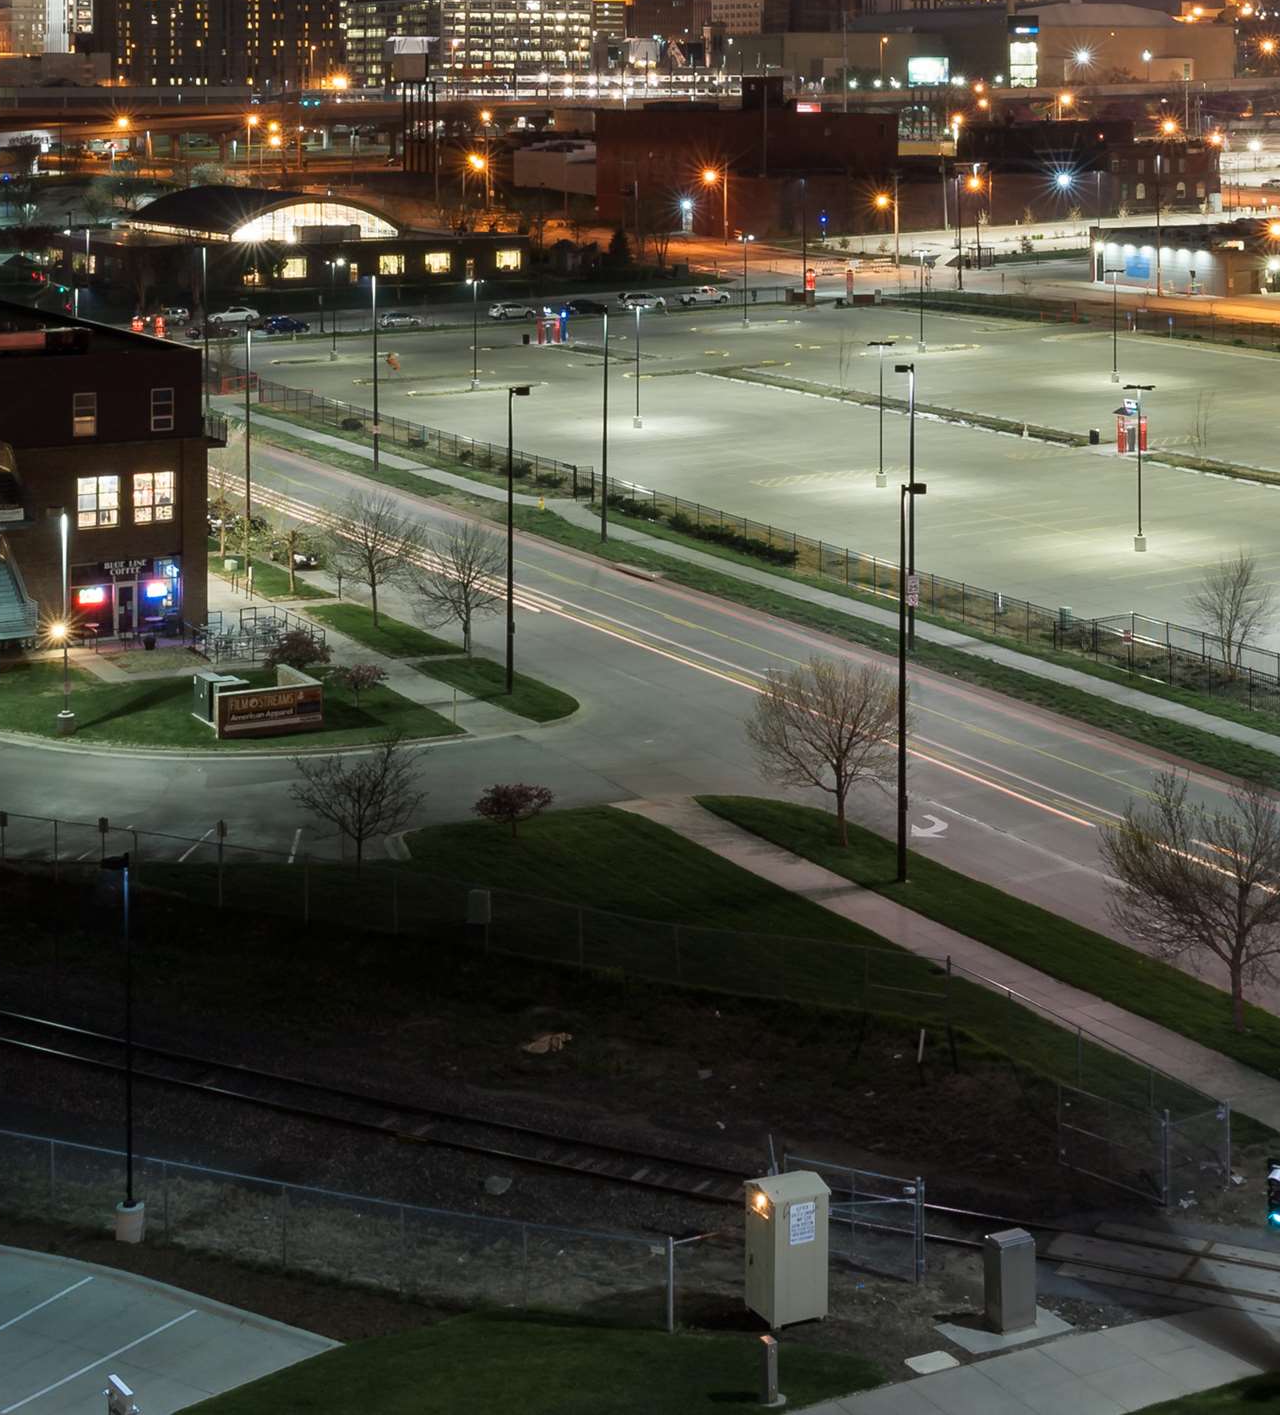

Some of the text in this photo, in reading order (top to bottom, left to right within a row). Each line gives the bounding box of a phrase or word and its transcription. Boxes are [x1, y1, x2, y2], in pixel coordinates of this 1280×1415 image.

[104, 559, 147, 569] BLUE LINE
[110, 566, 141, 576] COFFEE
[230, 692, 296, 711] FILM STREAMS
[230, 708, 295, 722] American Apparel
